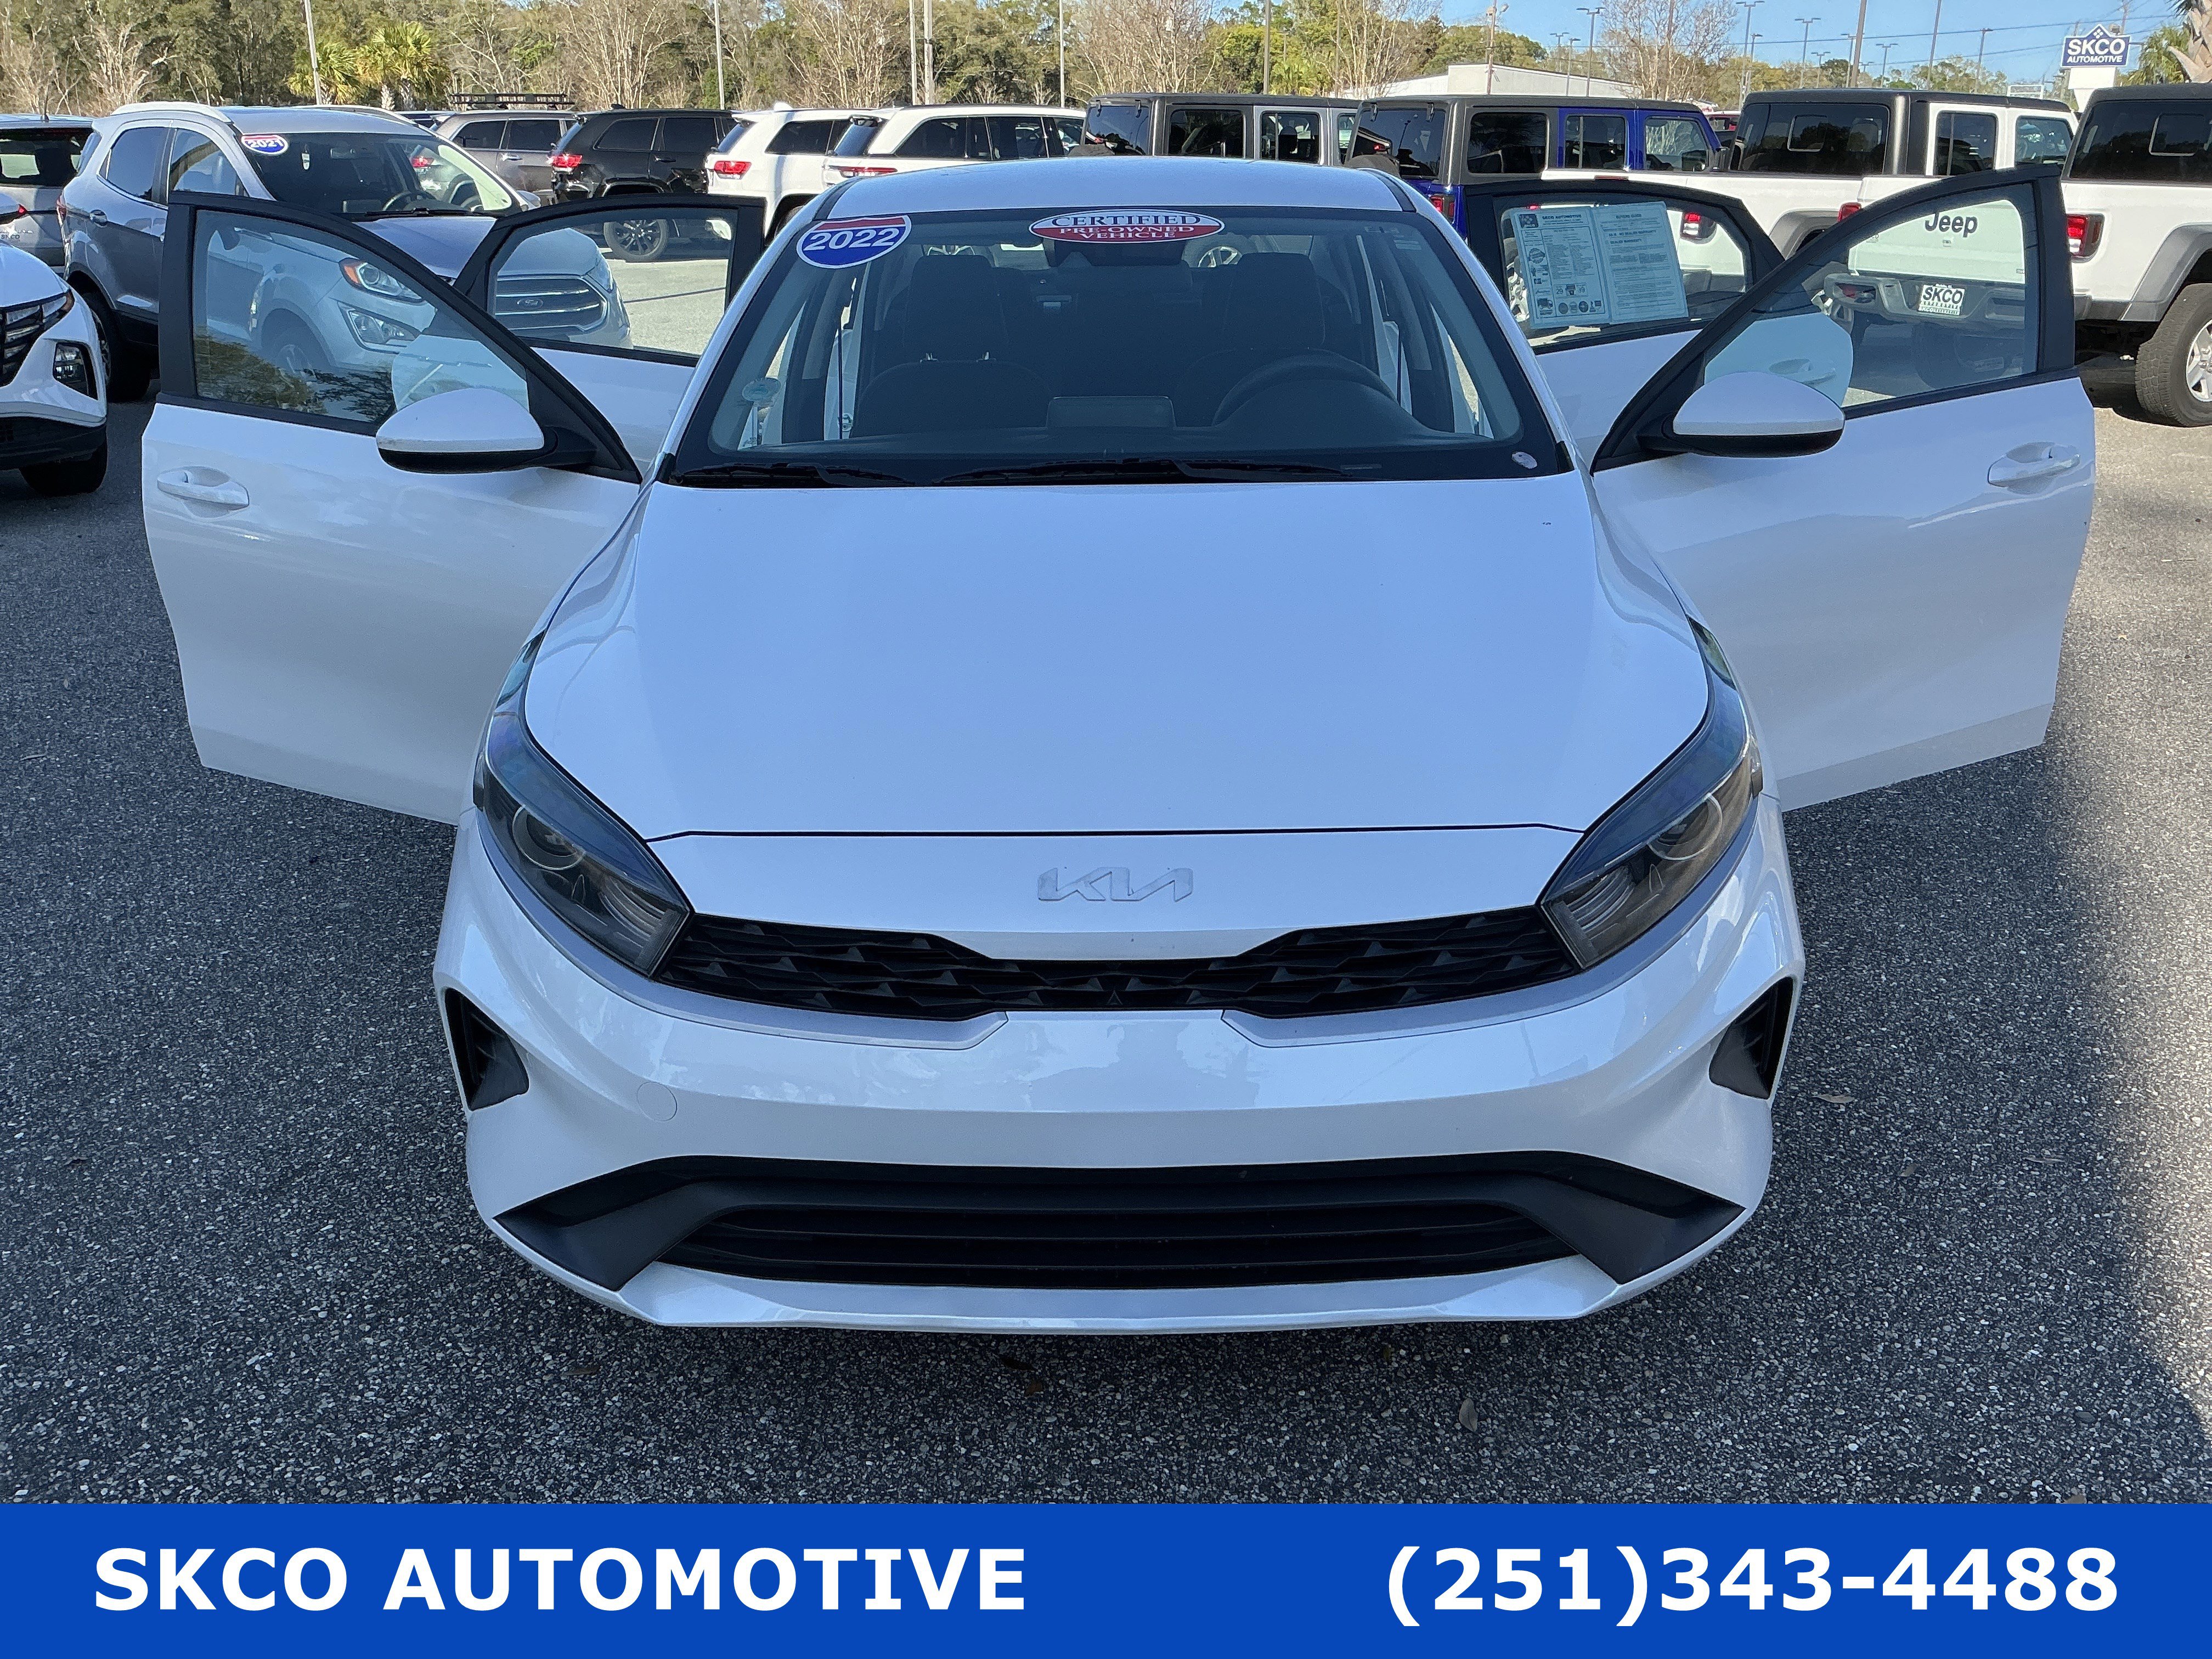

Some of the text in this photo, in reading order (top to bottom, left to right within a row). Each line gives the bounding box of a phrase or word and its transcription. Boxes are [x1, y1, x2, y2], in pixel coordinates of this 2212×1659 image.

[2067, 38, 2126, 55] SKCO
[247, 139, 285, 148] 2021
[1051, 215, 1201, 227] CERTIFIED
[1925, 212, 1978, 238] Jeep
[1059, 226, 1195, 235] PRE-OWNED
[803, 228, 900, 251] 2022
[1922, 286, 1963, 304] SKCO
